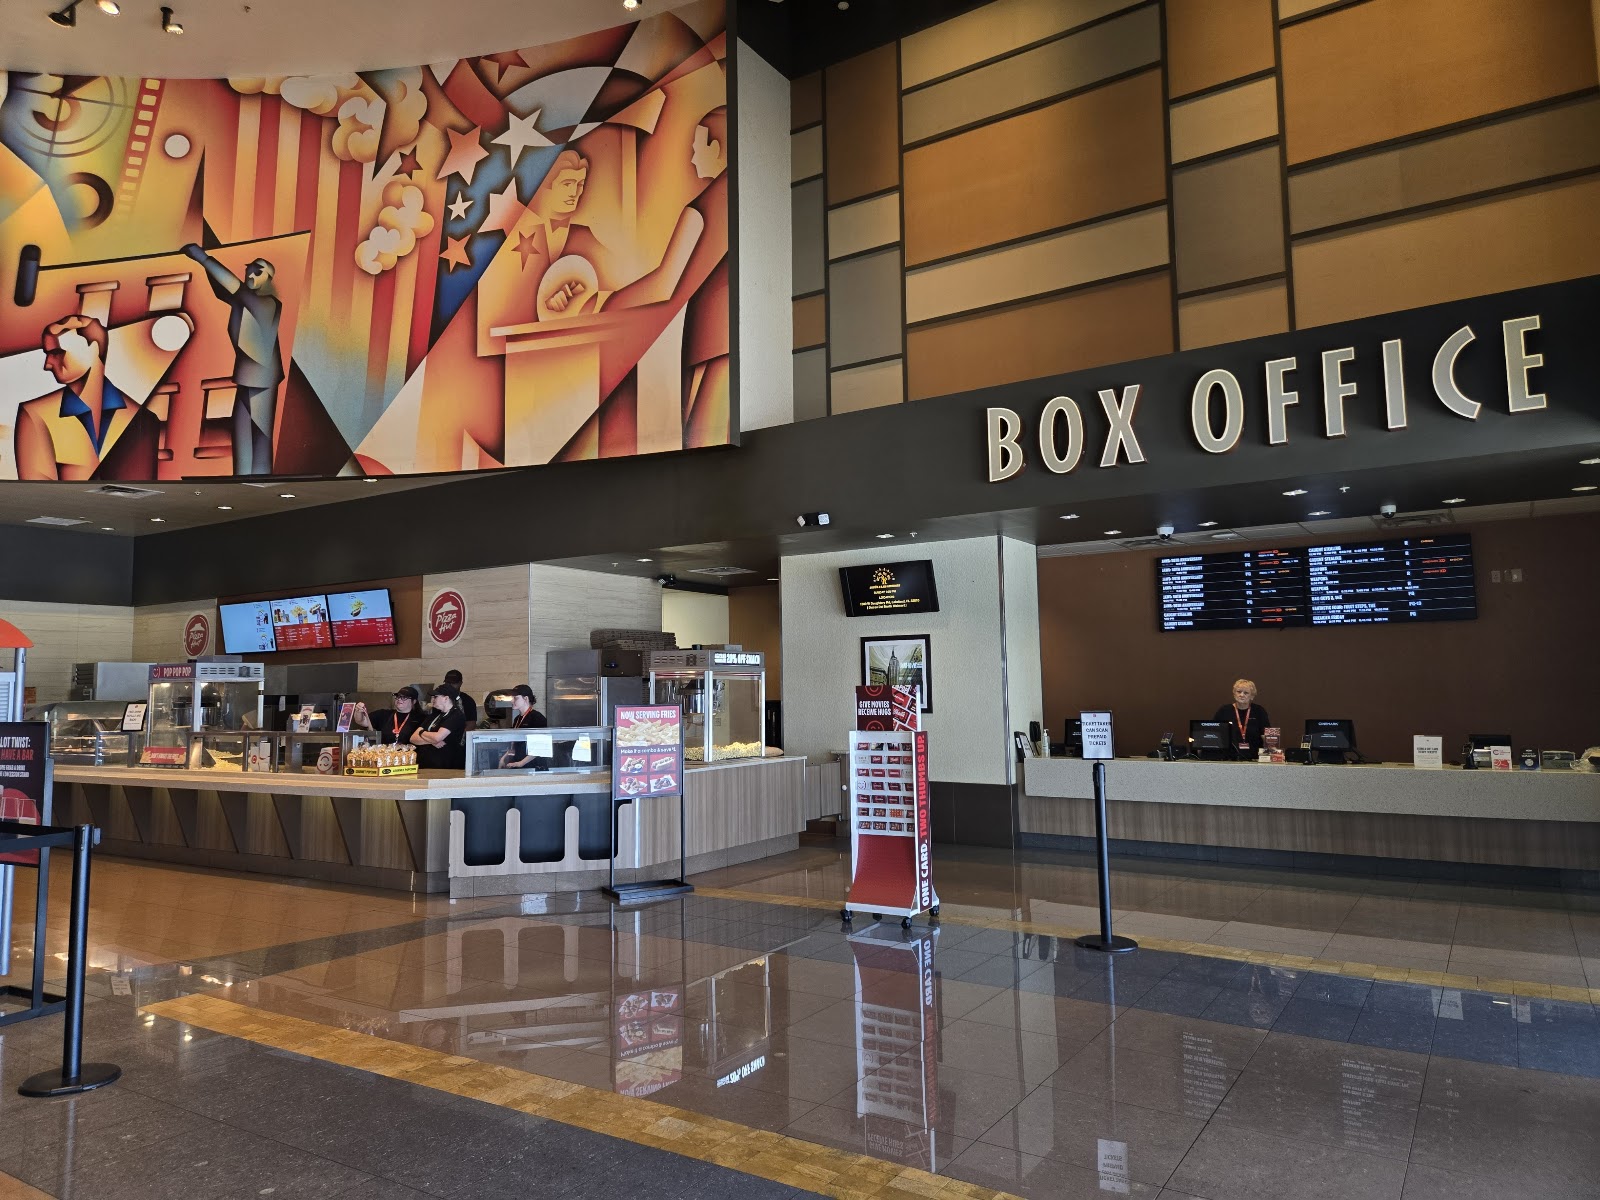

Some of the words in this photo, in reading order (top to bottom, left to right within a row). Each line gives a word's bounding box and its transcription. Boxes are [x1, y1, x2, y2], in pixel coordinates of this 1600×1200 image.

[986, 383, 1147, 483] BOX
[1190, 314, 1547, 454] OFFICE
[436, 612, 456, 627] Pizza
[439, 620, 455, 634] Hut
[164, 667, 172, 677] POP
[173, 667, 181, 676] POP
[182, 666, 191, 676] POP
[620, 711, 635, 720] NOW
[636, 710, 660, 719] SERVING
[661, 710, 676, 718] FRIES
[0, 736, 11, 748] LOT
[12, 736, 30, 748] TWIST:
[917, 734, 925, 752] UP.
[1, 749, 16, 760] HAVE
[16, 749, 21, 760] A
[22, 749, 34, 760] BAR
[916, 754, 927, 809] THUMBS
[919, 808, 928, 838] TWO
[920, 838, 928, 878] CARD.
[921, 878, 930, 907] ONE
